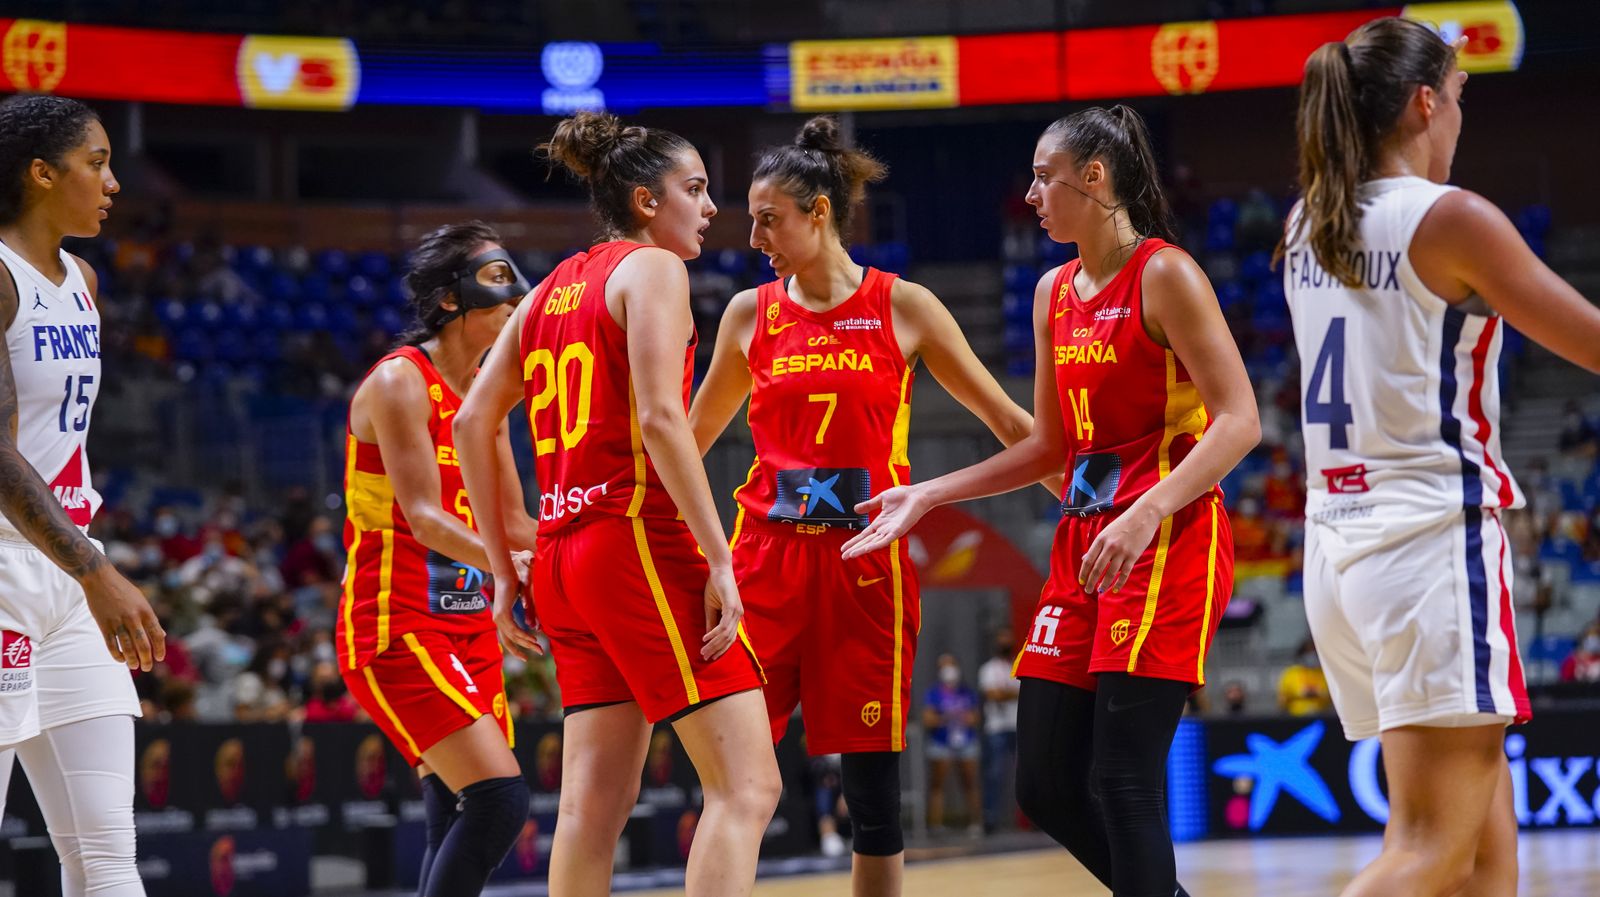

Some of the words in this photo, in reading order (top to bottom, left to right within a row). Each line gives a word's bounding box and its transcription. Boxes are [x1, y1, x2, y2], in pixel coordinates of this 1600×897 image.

[253, 53, 336, 95] VS
[33, 324, 101, 361] FRANCE
[772, 349, 874, 376] ESPAÑA
[59, 375, 94, 432] 15
[524, 342, 594, 457] 20
[1306, 317, 1353, 449] 4
[808, 393, 838, 445] 7
[1068, 388, 1094, 441] 14
[796, 523, 827, 535] ESP
[1031, 605, 1063, 645] fi
[2, 671, 29, 682] CAISSE
